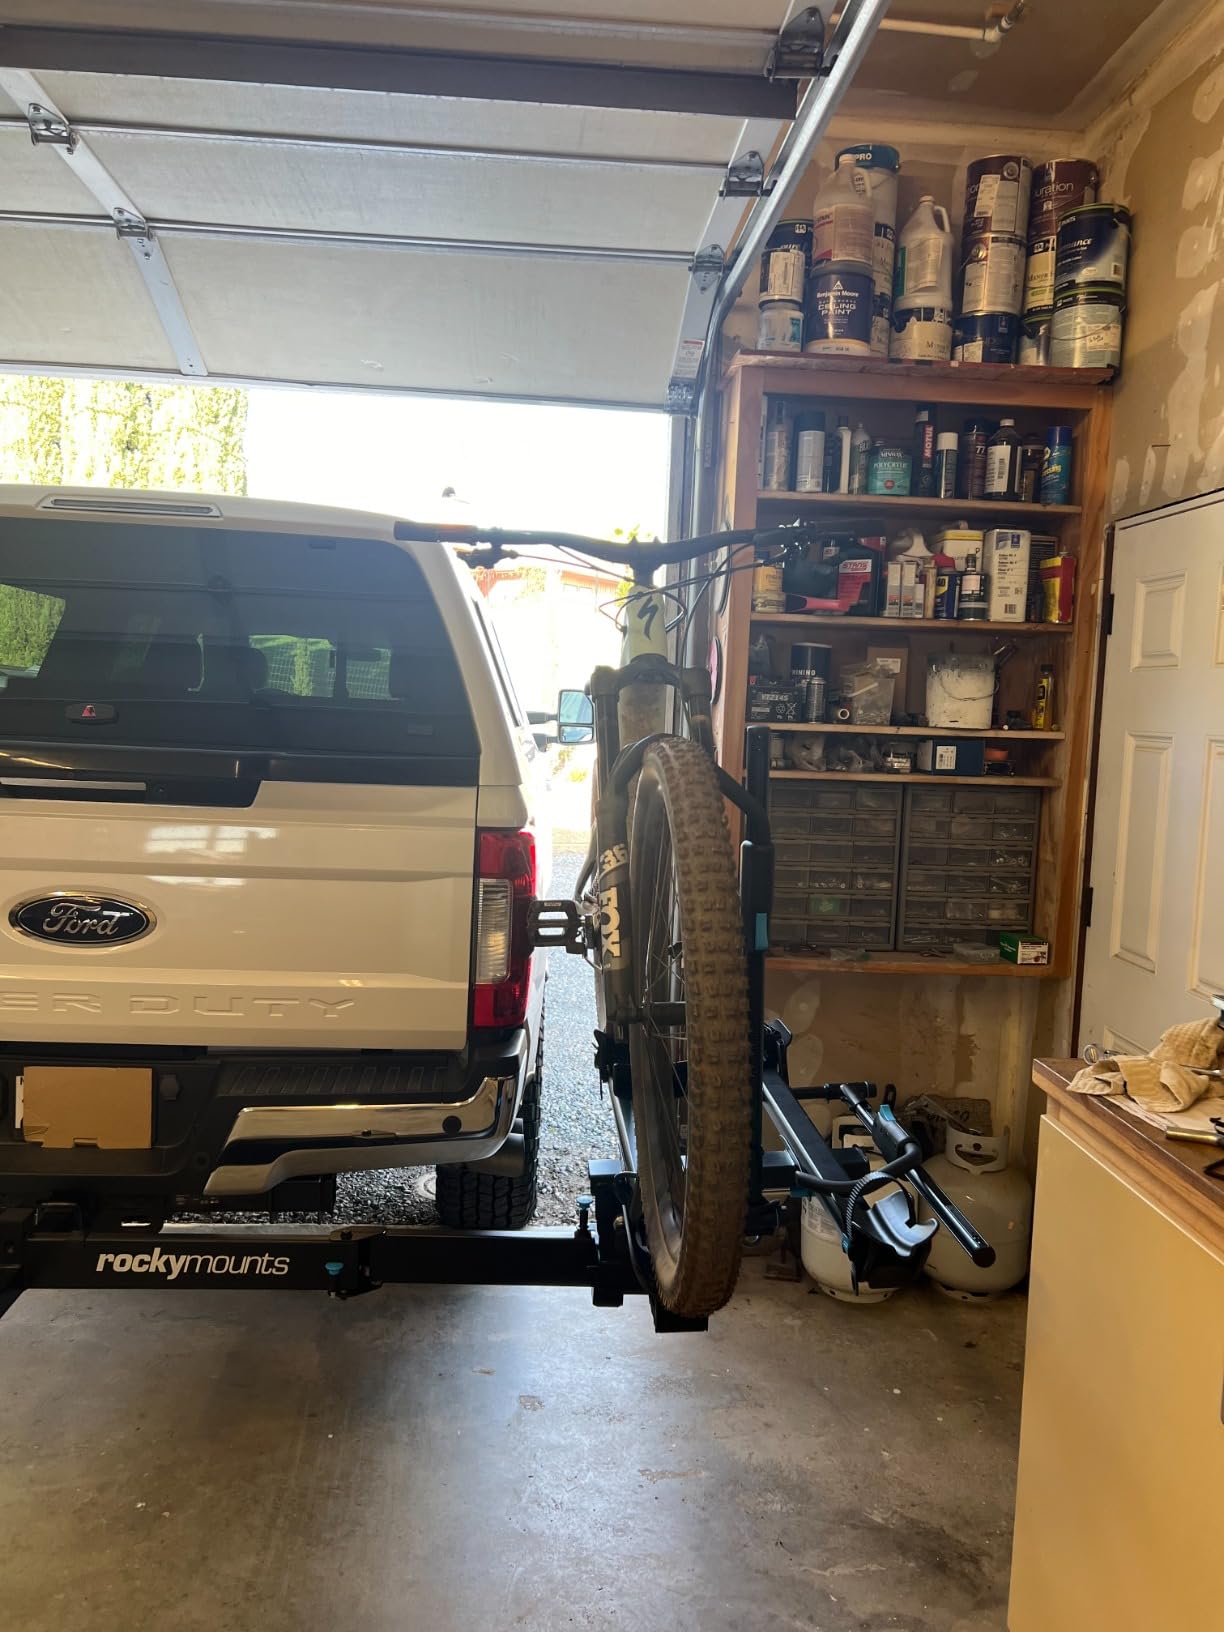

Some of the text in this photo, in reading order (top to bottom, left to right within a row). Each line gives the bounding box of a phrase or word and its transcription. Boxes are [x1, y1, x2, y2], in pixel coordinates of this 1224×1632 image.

[818, 303, 857, 311] CELING
[924, 425, 934, 458] MOTUL
[975, 445, 986, 454] 77
[600, 843, 629, 871] 36
[43, 902, 121, 935] Ford
[599, 886, 621, 958] FOX
[130, 994, 354, 1017] DUTY
[96, 1247, 290, 1280] rockymounts
